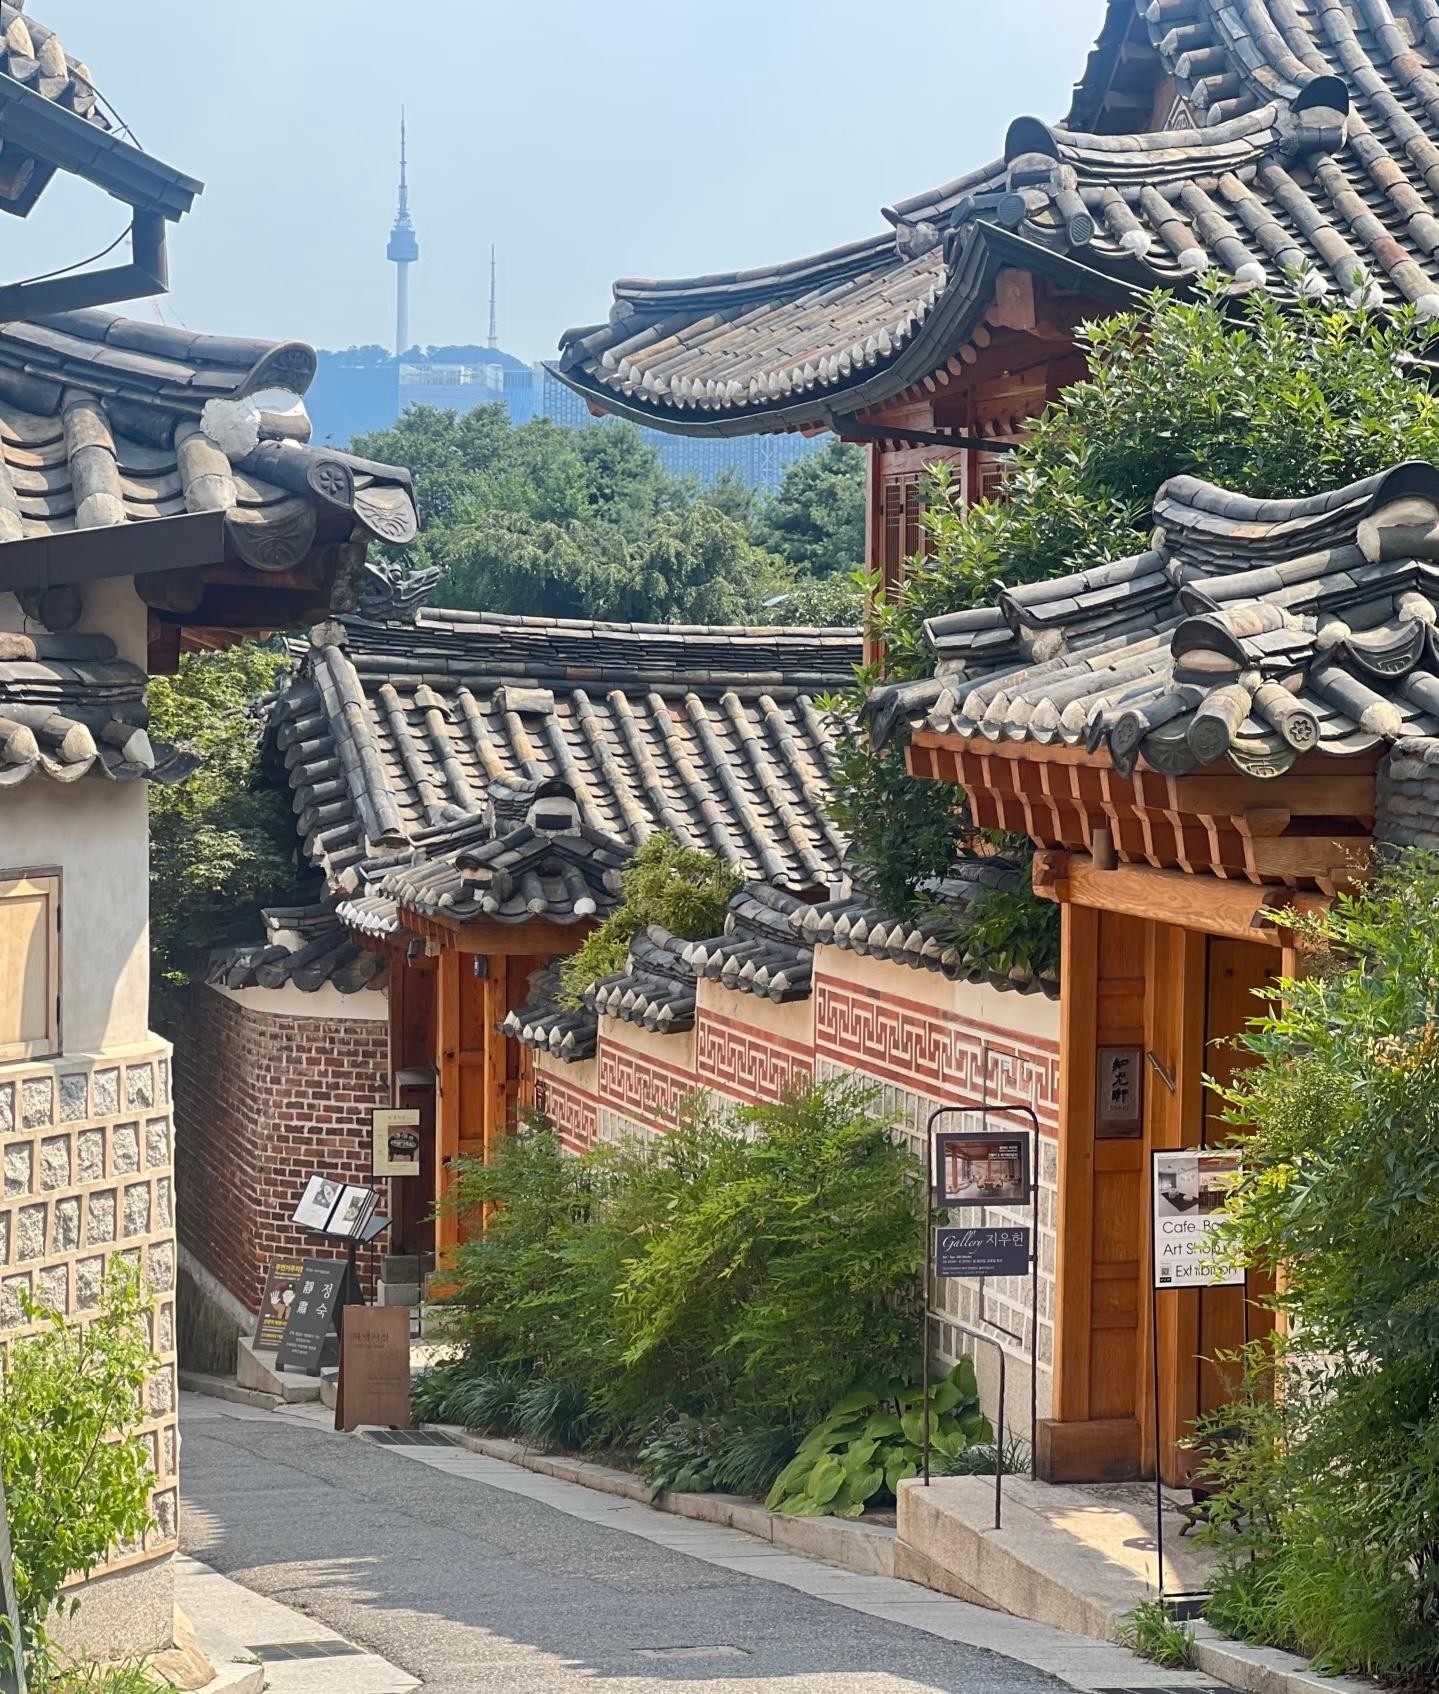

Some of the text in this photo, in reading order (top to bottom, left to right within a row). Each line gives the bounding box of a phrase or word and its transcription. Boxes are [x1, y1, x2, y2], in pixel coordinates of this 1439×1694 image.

[1162, 1220, 1196, 1234] Cafe
[942, 1230, 1024, 1254] Gallery 지우헌
[1163, 1243, 1182, 1255] Art
[316, 1283, 334, 1319] 정숙
